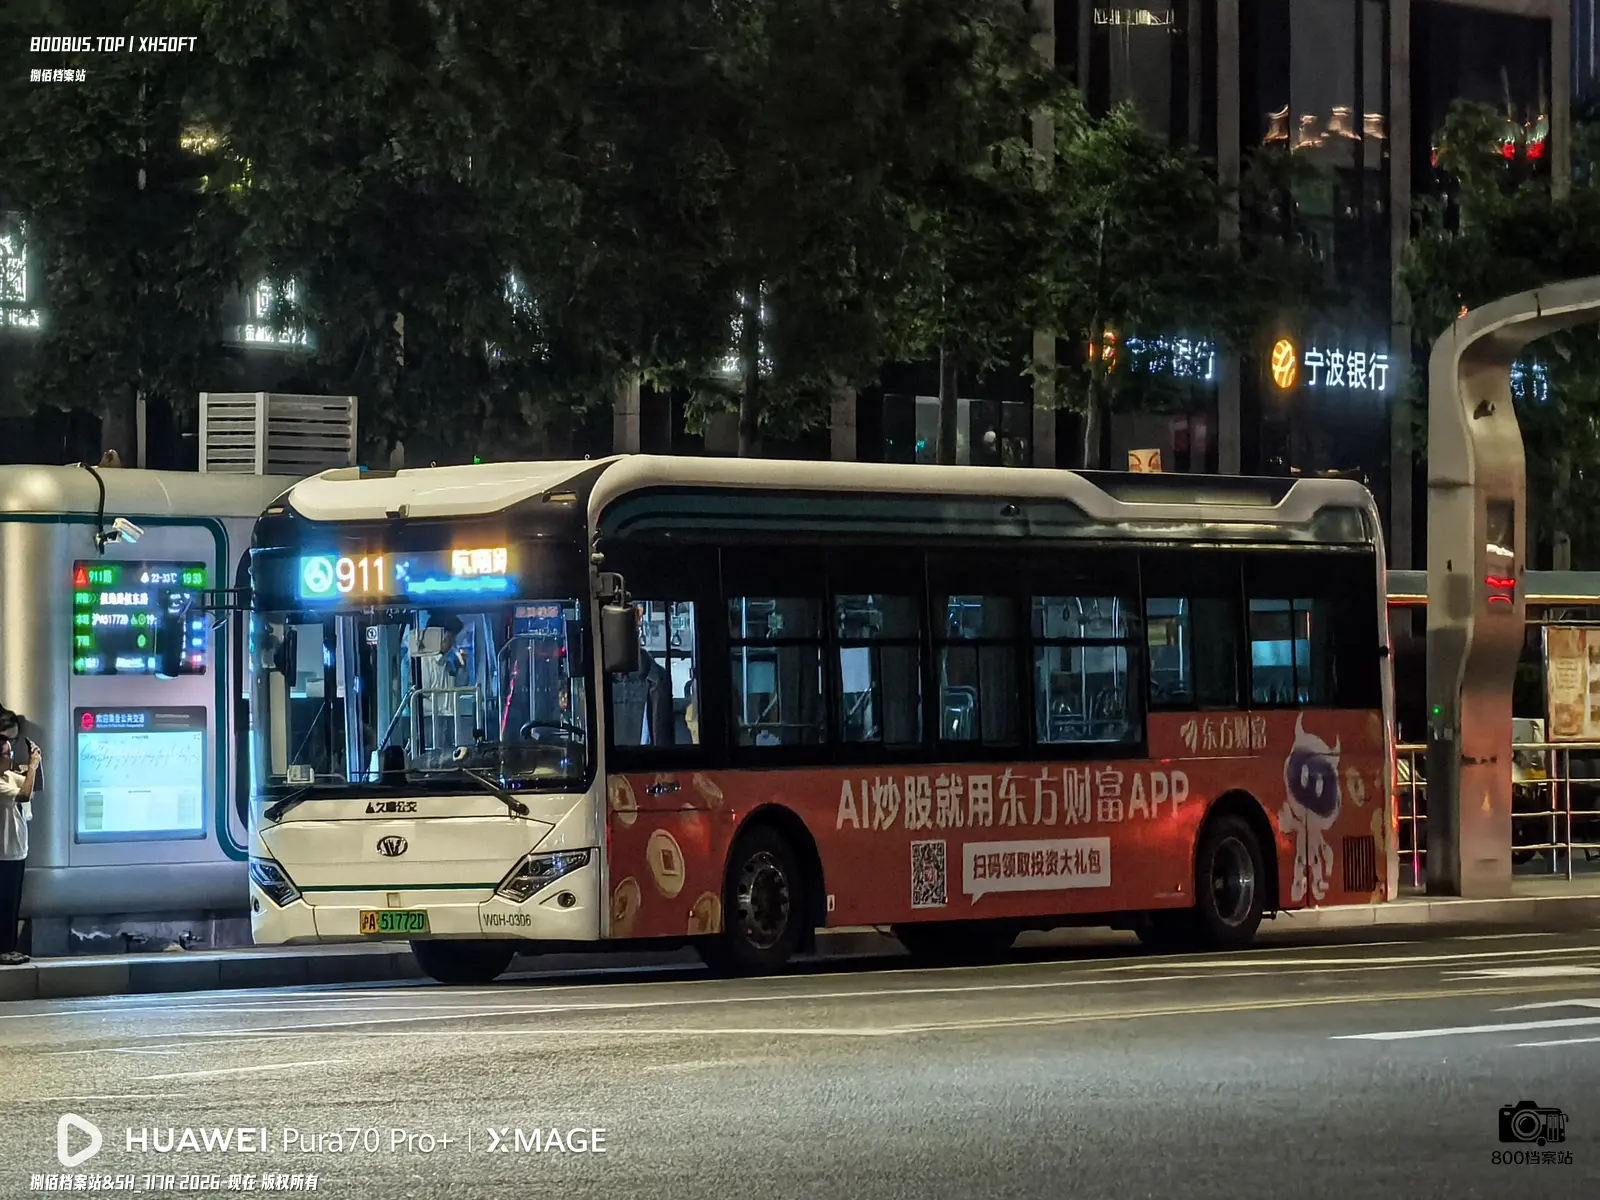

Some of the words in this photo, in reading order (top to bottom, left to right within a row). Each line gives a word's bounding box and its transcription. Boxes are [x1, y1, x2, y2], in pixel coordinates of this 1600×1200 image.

[1304, 346, 1390, 391] 宁波银行
[335, 556, 384, 593] 911
[1203, 716, 1267, 750] 东方财富
[836, 765, 1190, 831] AI炒股就用东方财富APP
[973, 848, 1102, 880] 扫码领取投资大礼包
